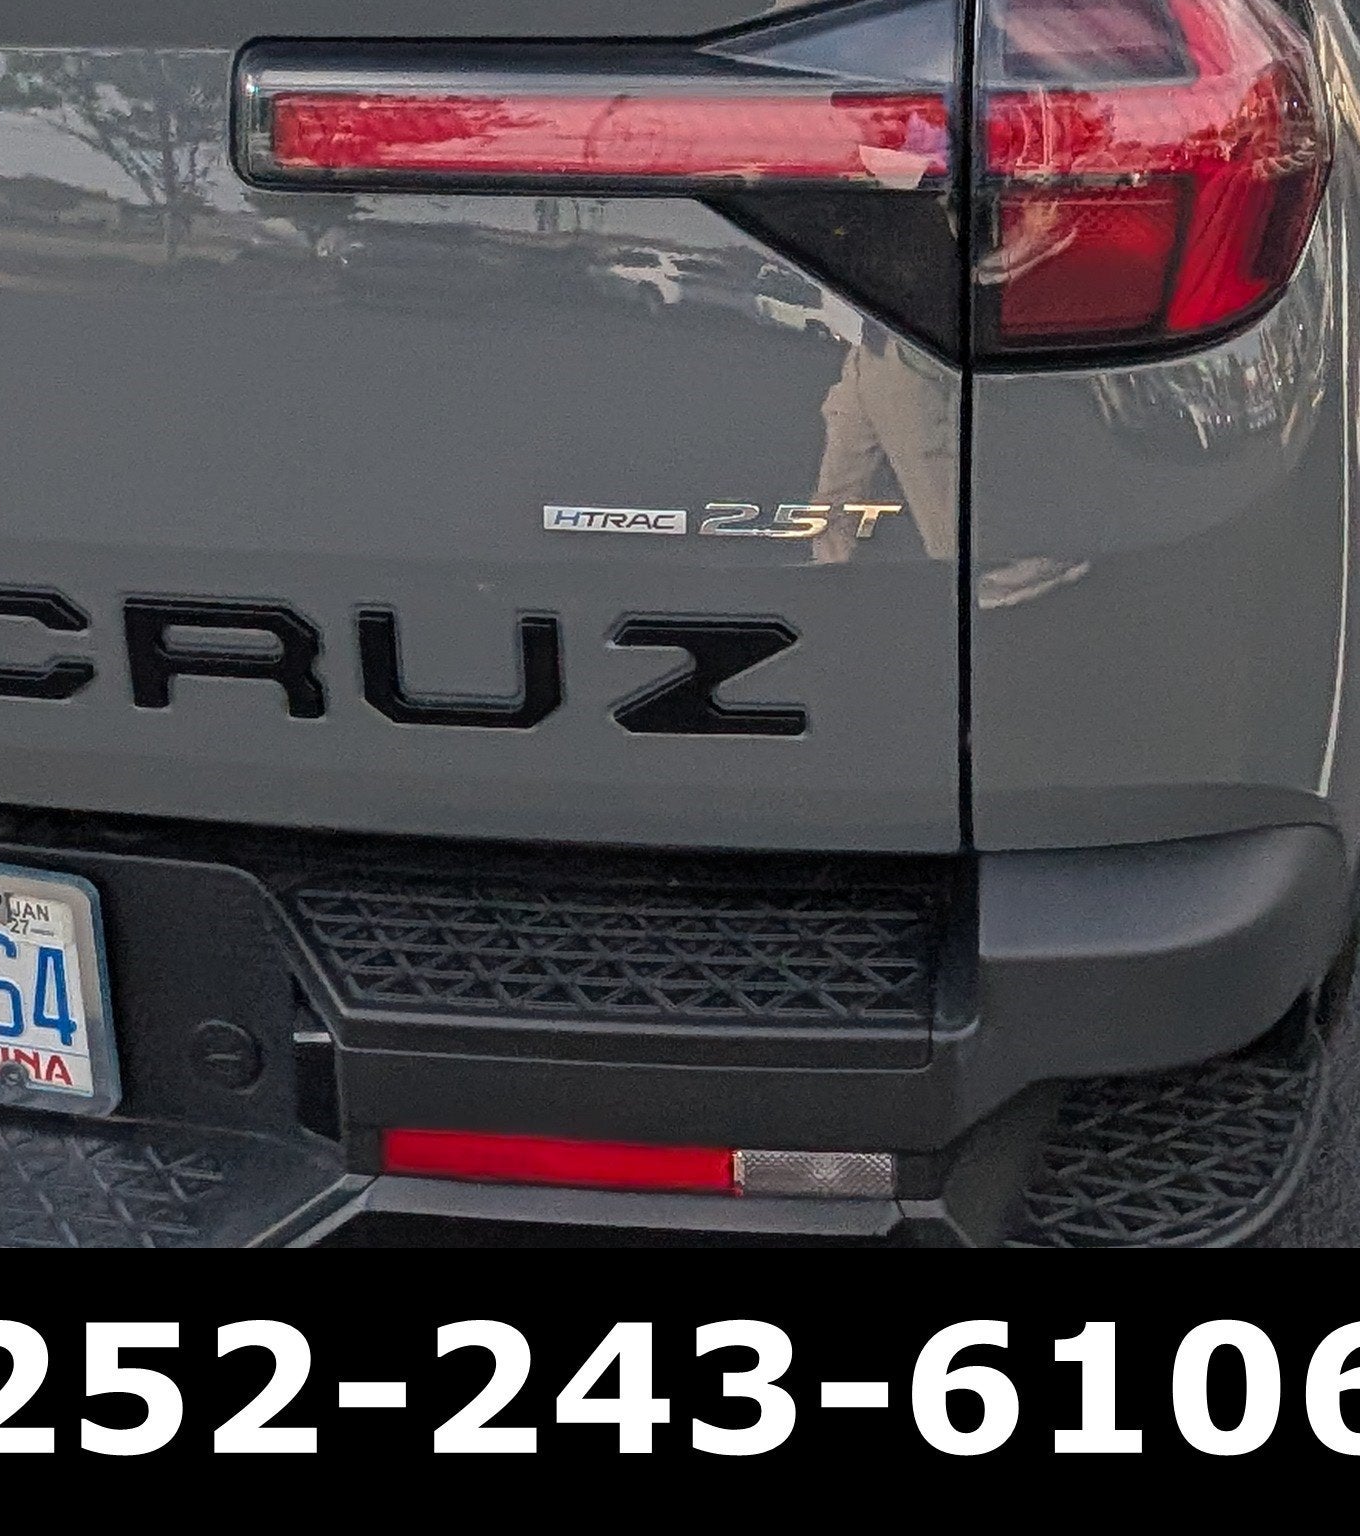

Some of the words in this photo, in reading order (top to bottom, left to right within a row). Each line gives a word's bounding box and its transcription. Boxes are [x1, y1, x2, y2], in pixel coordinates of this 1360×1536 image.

[553, 510, 677, 531] HTRAC
[10, 901, 50, 922] JAN
[7, 917, 30, 936] 27
